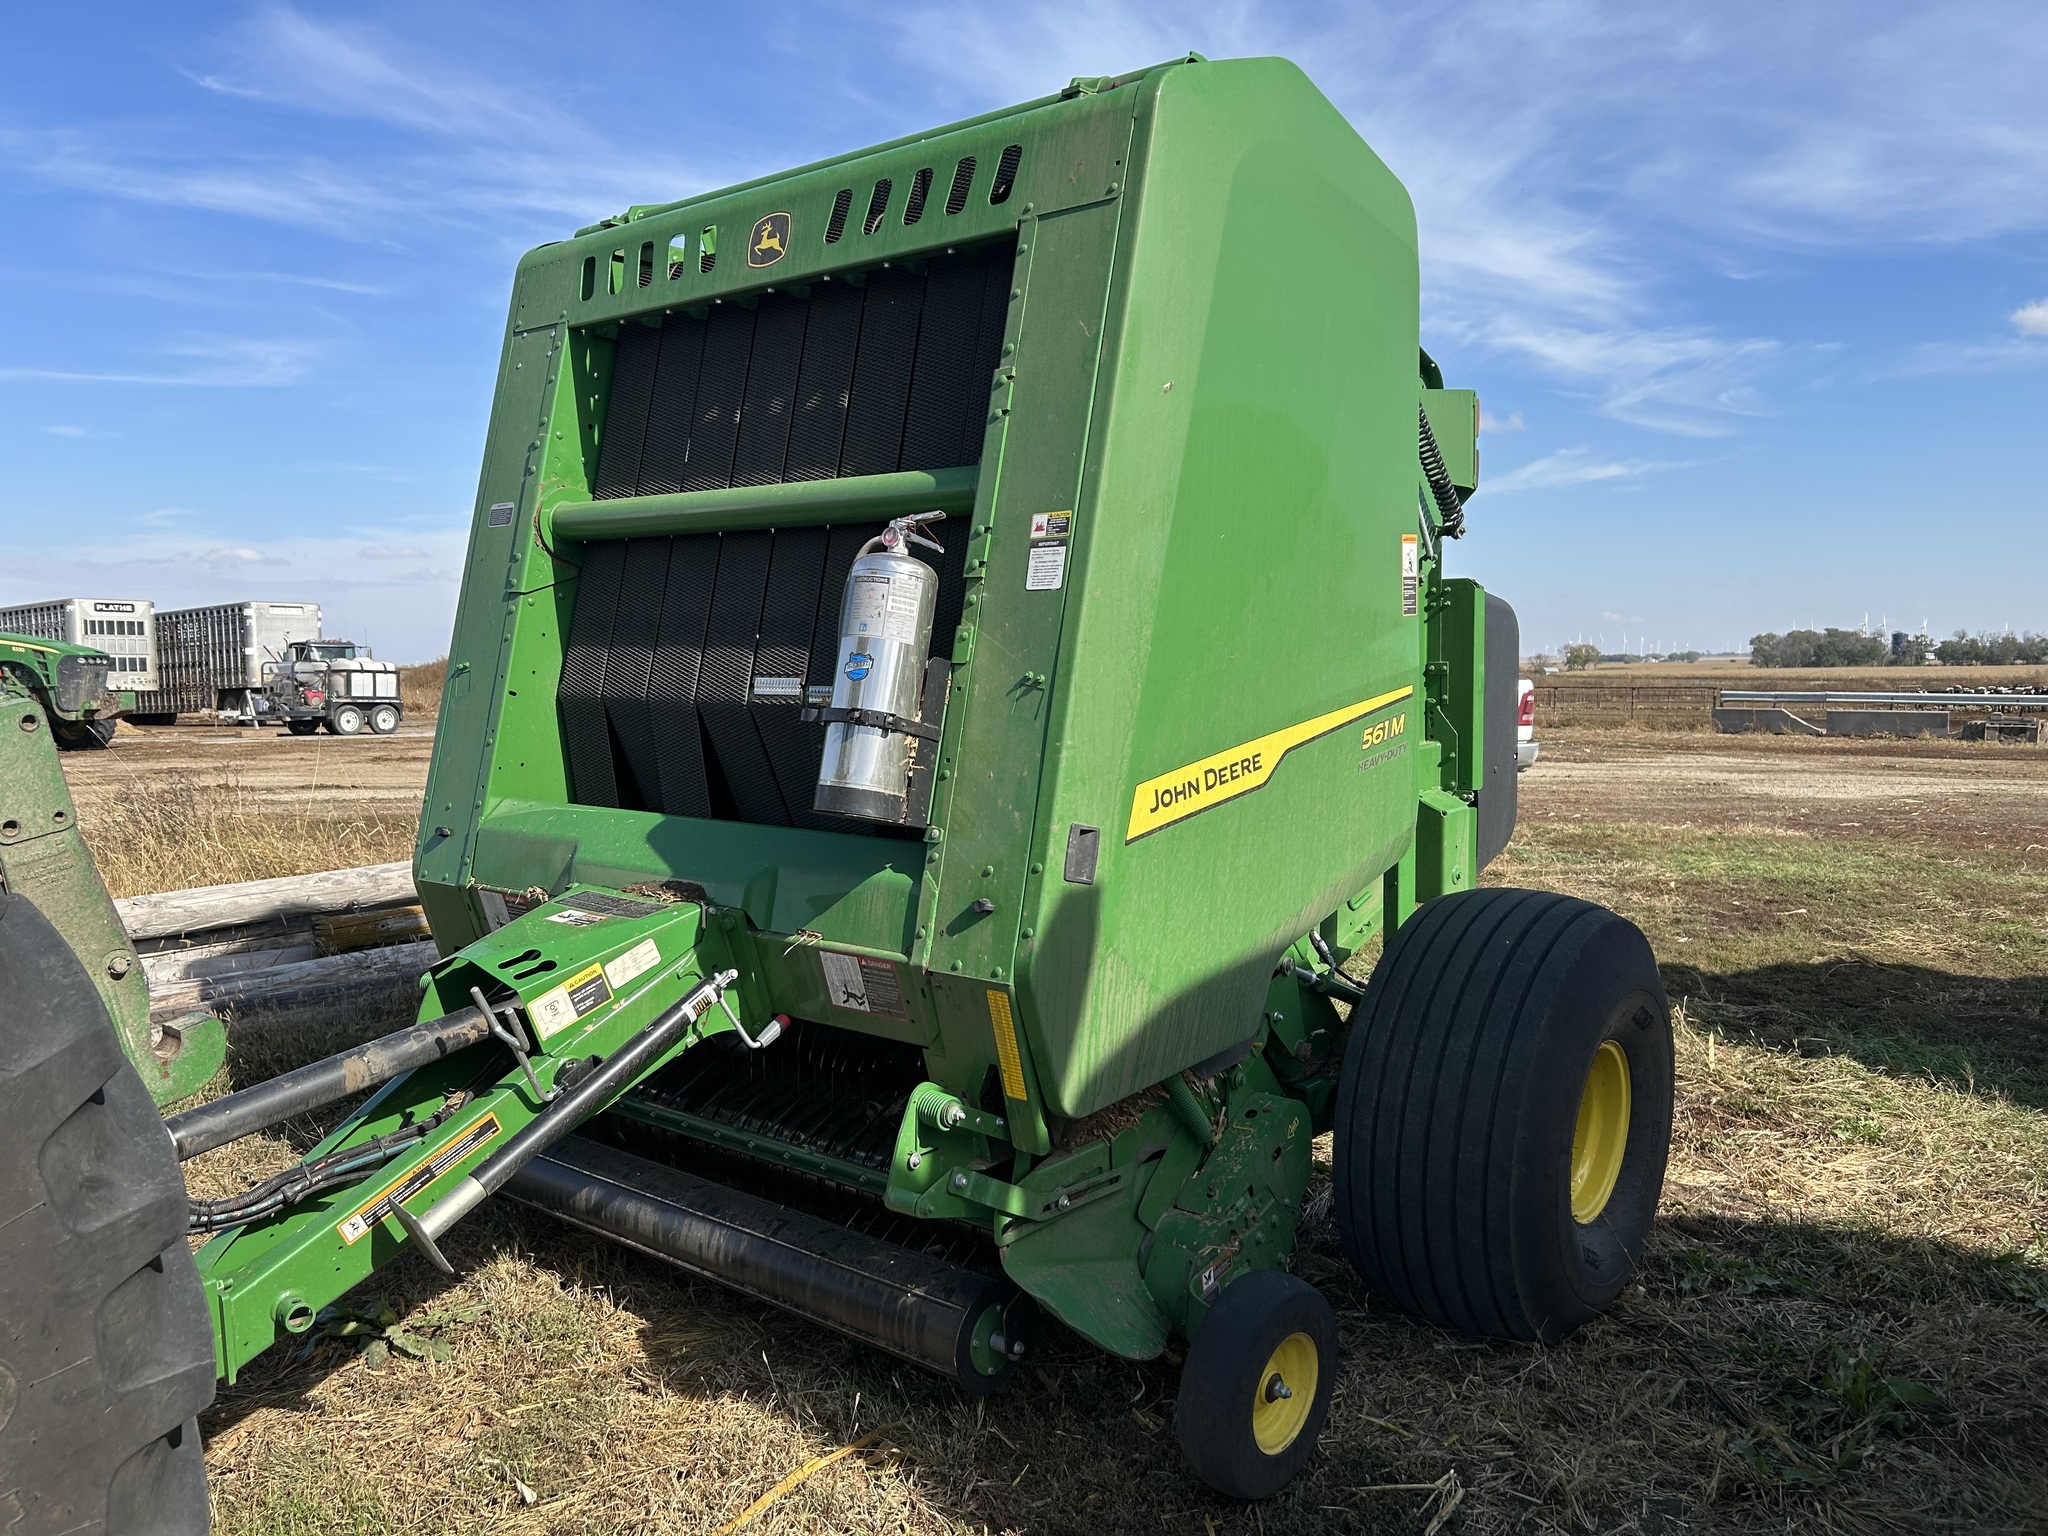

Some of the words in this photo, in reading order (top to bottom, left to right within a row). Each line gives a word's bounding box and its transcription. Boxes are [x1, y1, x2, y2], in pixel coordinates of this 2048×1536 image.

[1150, 777, 1200, 813] JOHN
[1204, 752, 1262, 791] DEERE
[868, 960, 892, 969] DANGER
[574, 969, 598, 985] CAUTION
[416, 1151, 443, 1171] WARNING
